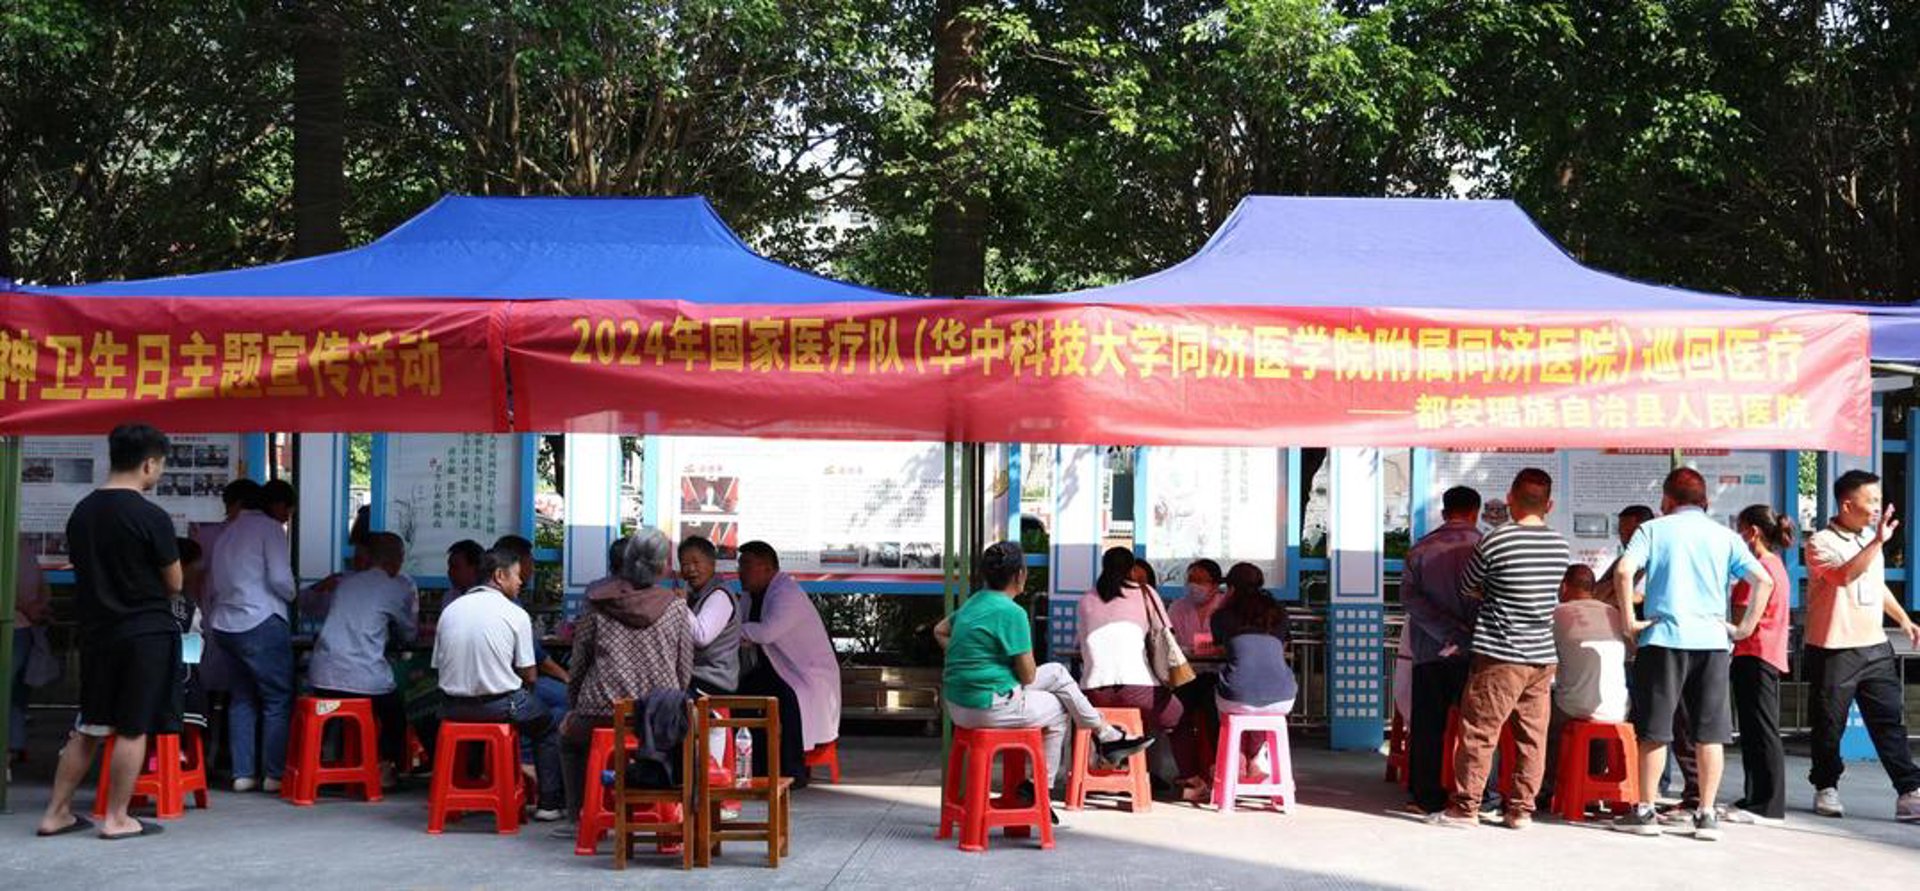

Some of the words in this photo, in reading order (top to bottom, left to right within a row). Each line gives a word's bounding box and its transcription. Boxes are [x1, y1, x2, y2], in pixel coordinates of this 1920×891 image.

[0, 329, 441, 400] 神卫生日主题宣传活动
